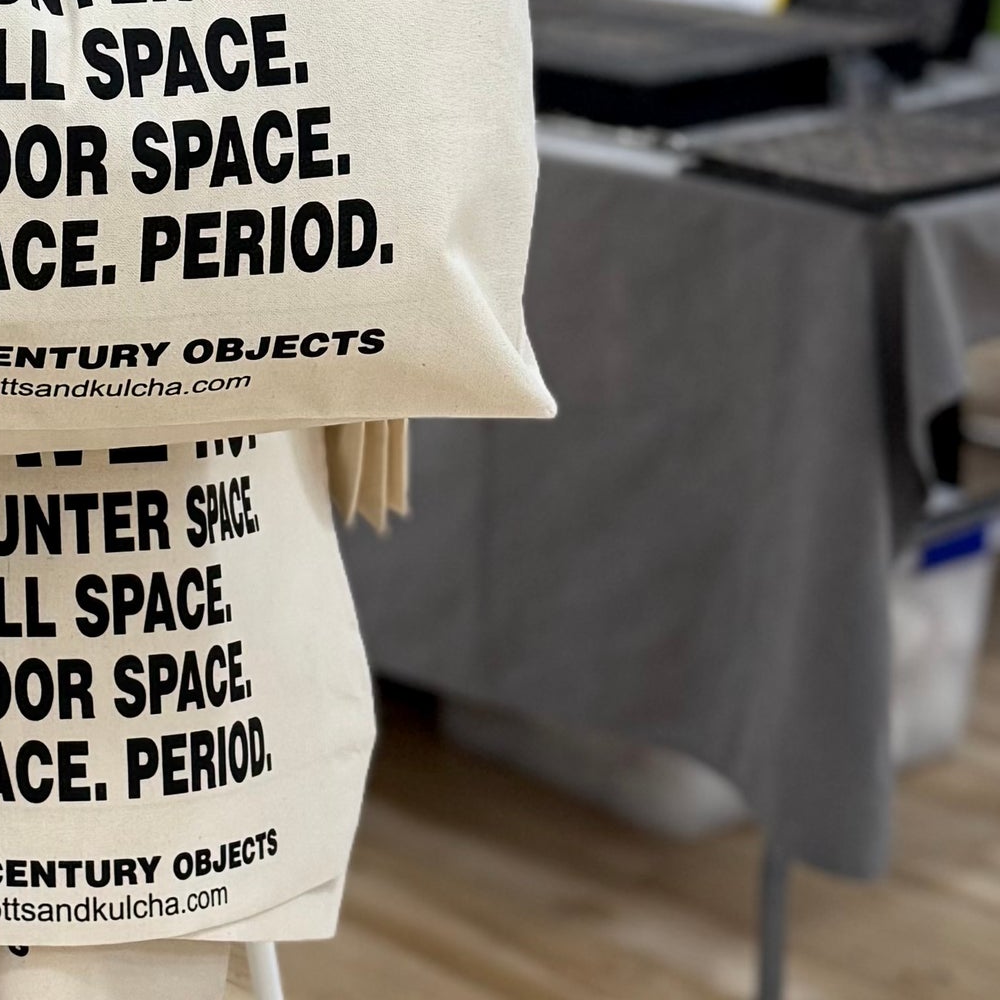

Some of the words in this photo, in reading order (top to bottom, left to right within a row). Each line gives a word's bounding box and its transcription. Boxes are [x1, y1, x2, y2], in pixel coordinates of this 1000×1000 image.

[81, 13, 309, 101] SPACE.
[131, 106, 351, 195] SPACE.
[139, 198, 394, 283] PERIOD.
[182, 328, 386, 365] OBJECTS
[185, 475, 260, 549] SPACE.
[75, 563, 232, 638] SPACE.
[113, 640, 252, 719] SPACE.
[126, 716, 272, 800] PERIOD.
[172, 828, 278, 881] OBJECTS
